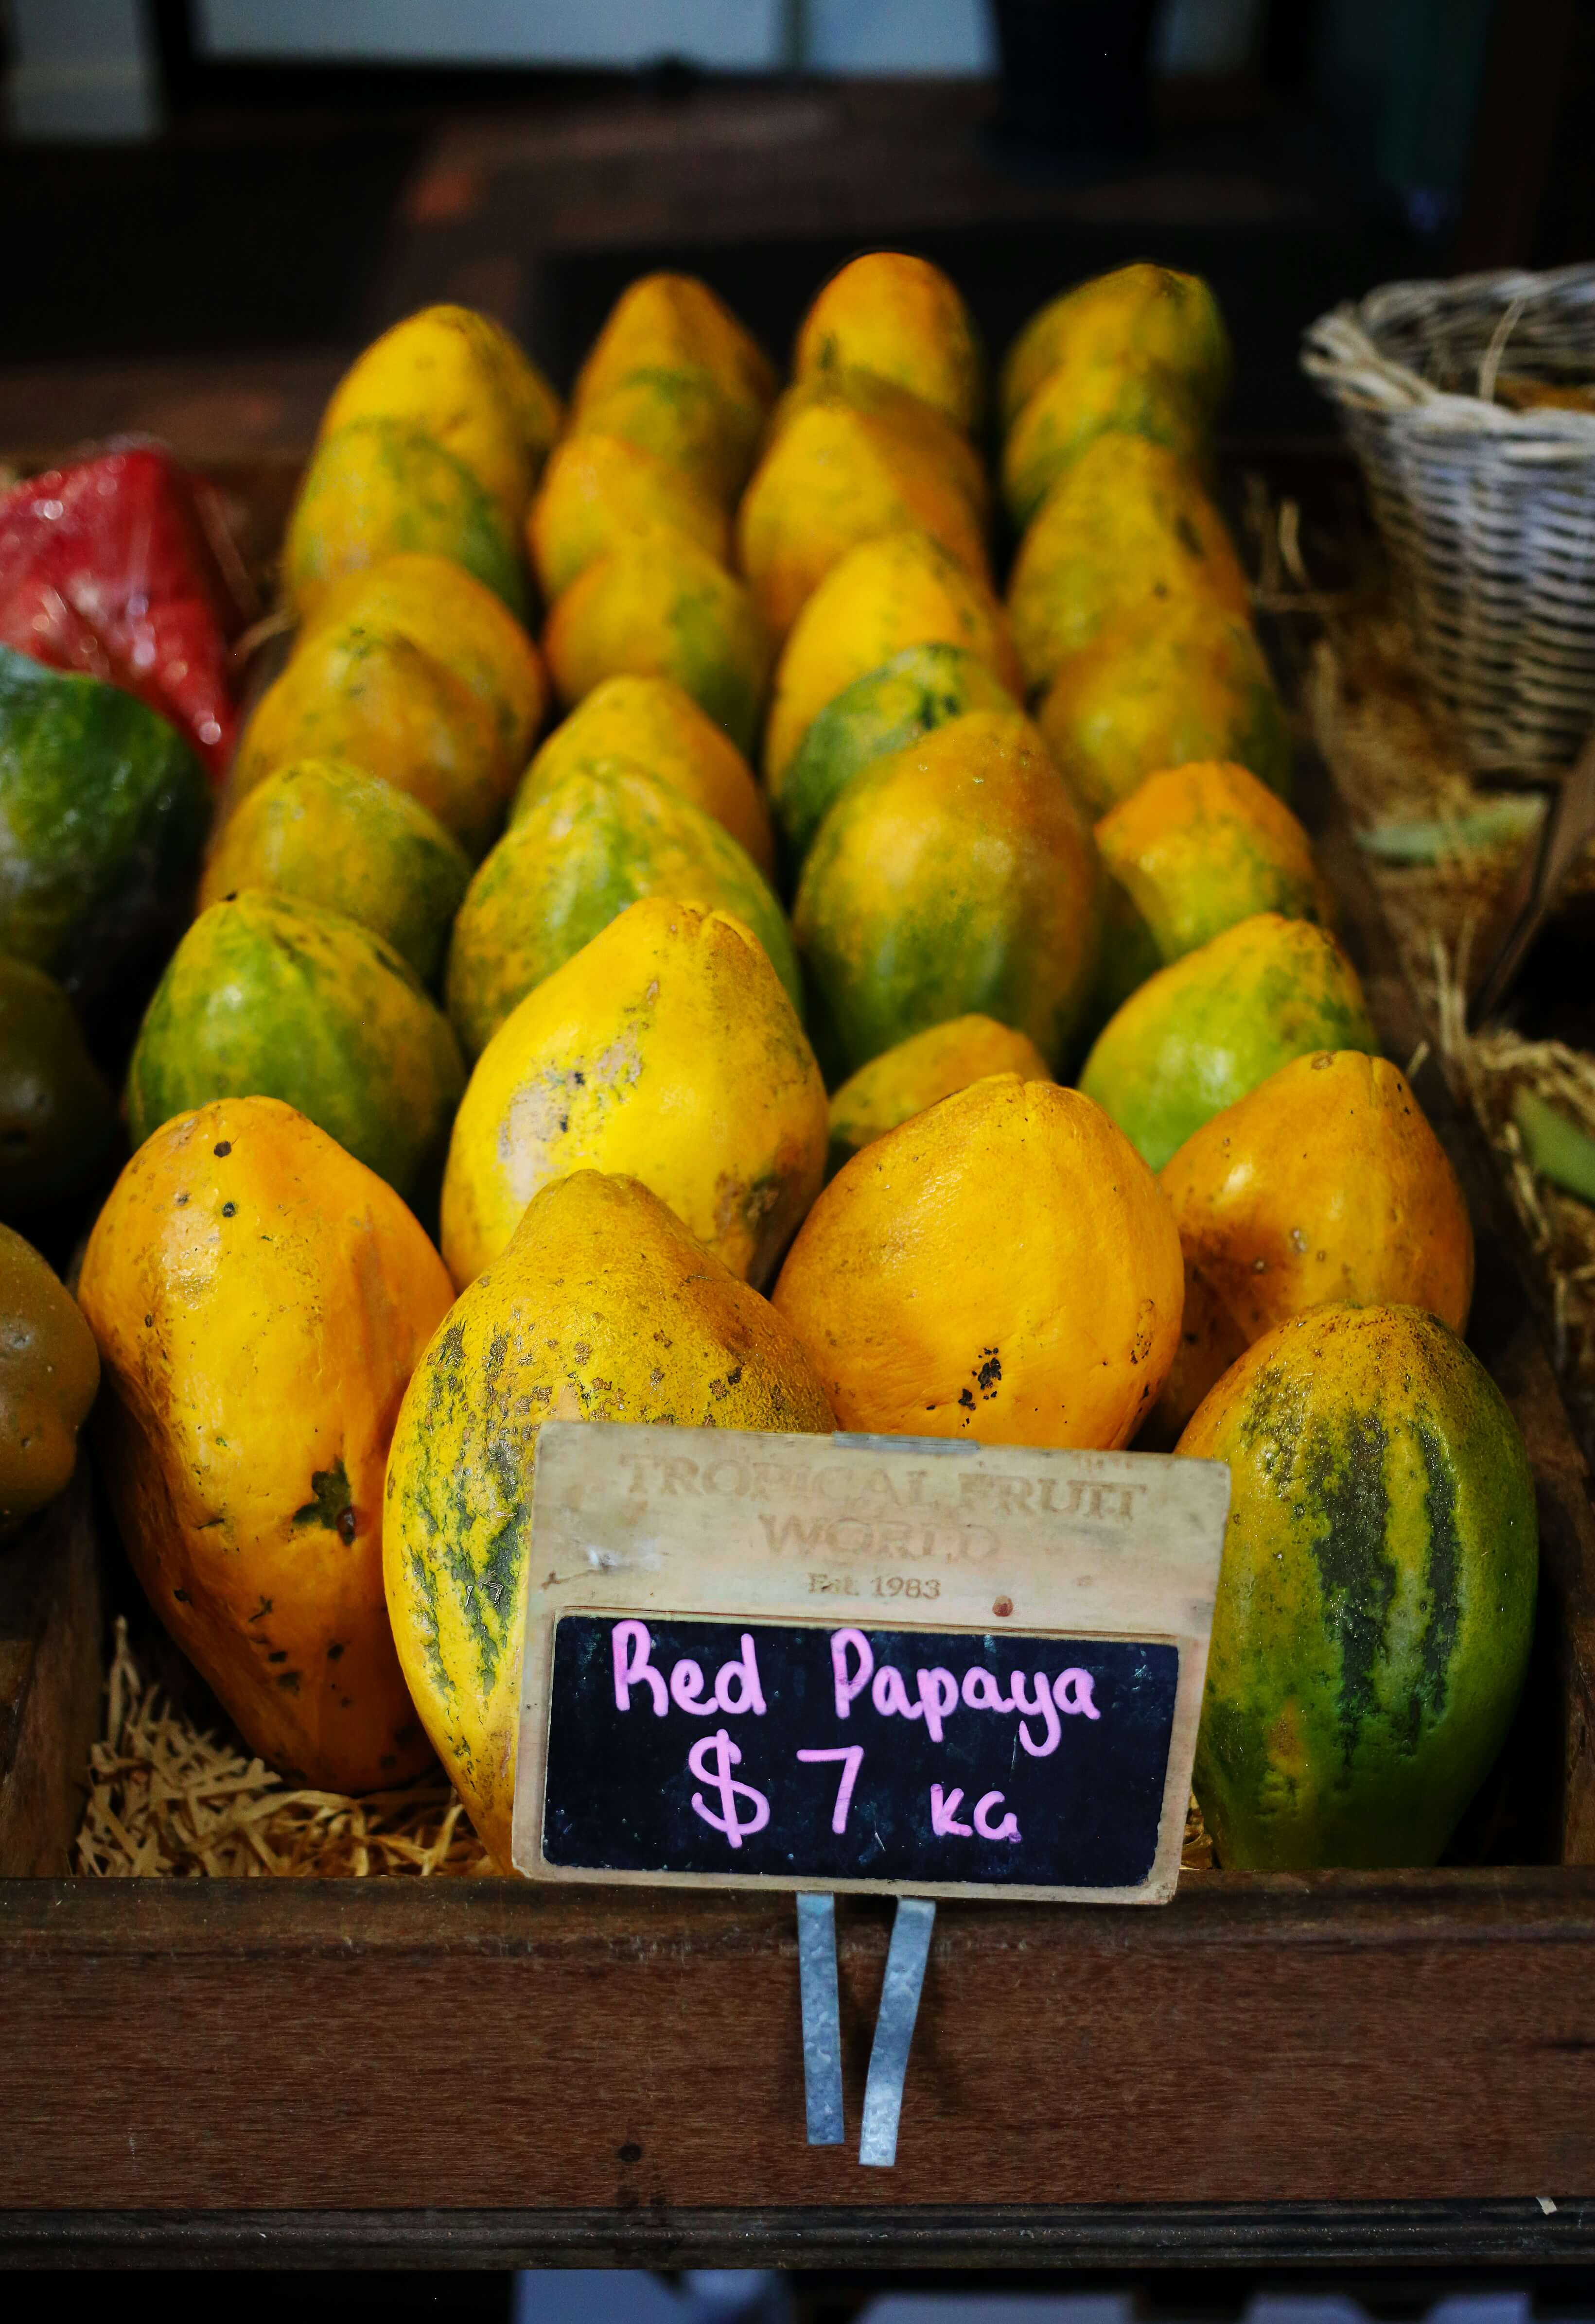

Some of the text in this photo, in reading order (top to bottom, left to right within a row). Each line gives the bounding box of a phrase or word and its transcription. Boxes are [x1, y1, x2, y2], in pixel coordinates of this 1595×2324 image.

[618, 1453, 1147, 1521] TROPICAL FRUIT
[758, 1513, 1000, 1561] WORLD
[869, 1576, 941, 1600] 1983
[612, 1620, 1101, 1757] Red Papaya
[688, 1728, 770, 1848] $
[796, 1745, 864, 1835] 7
